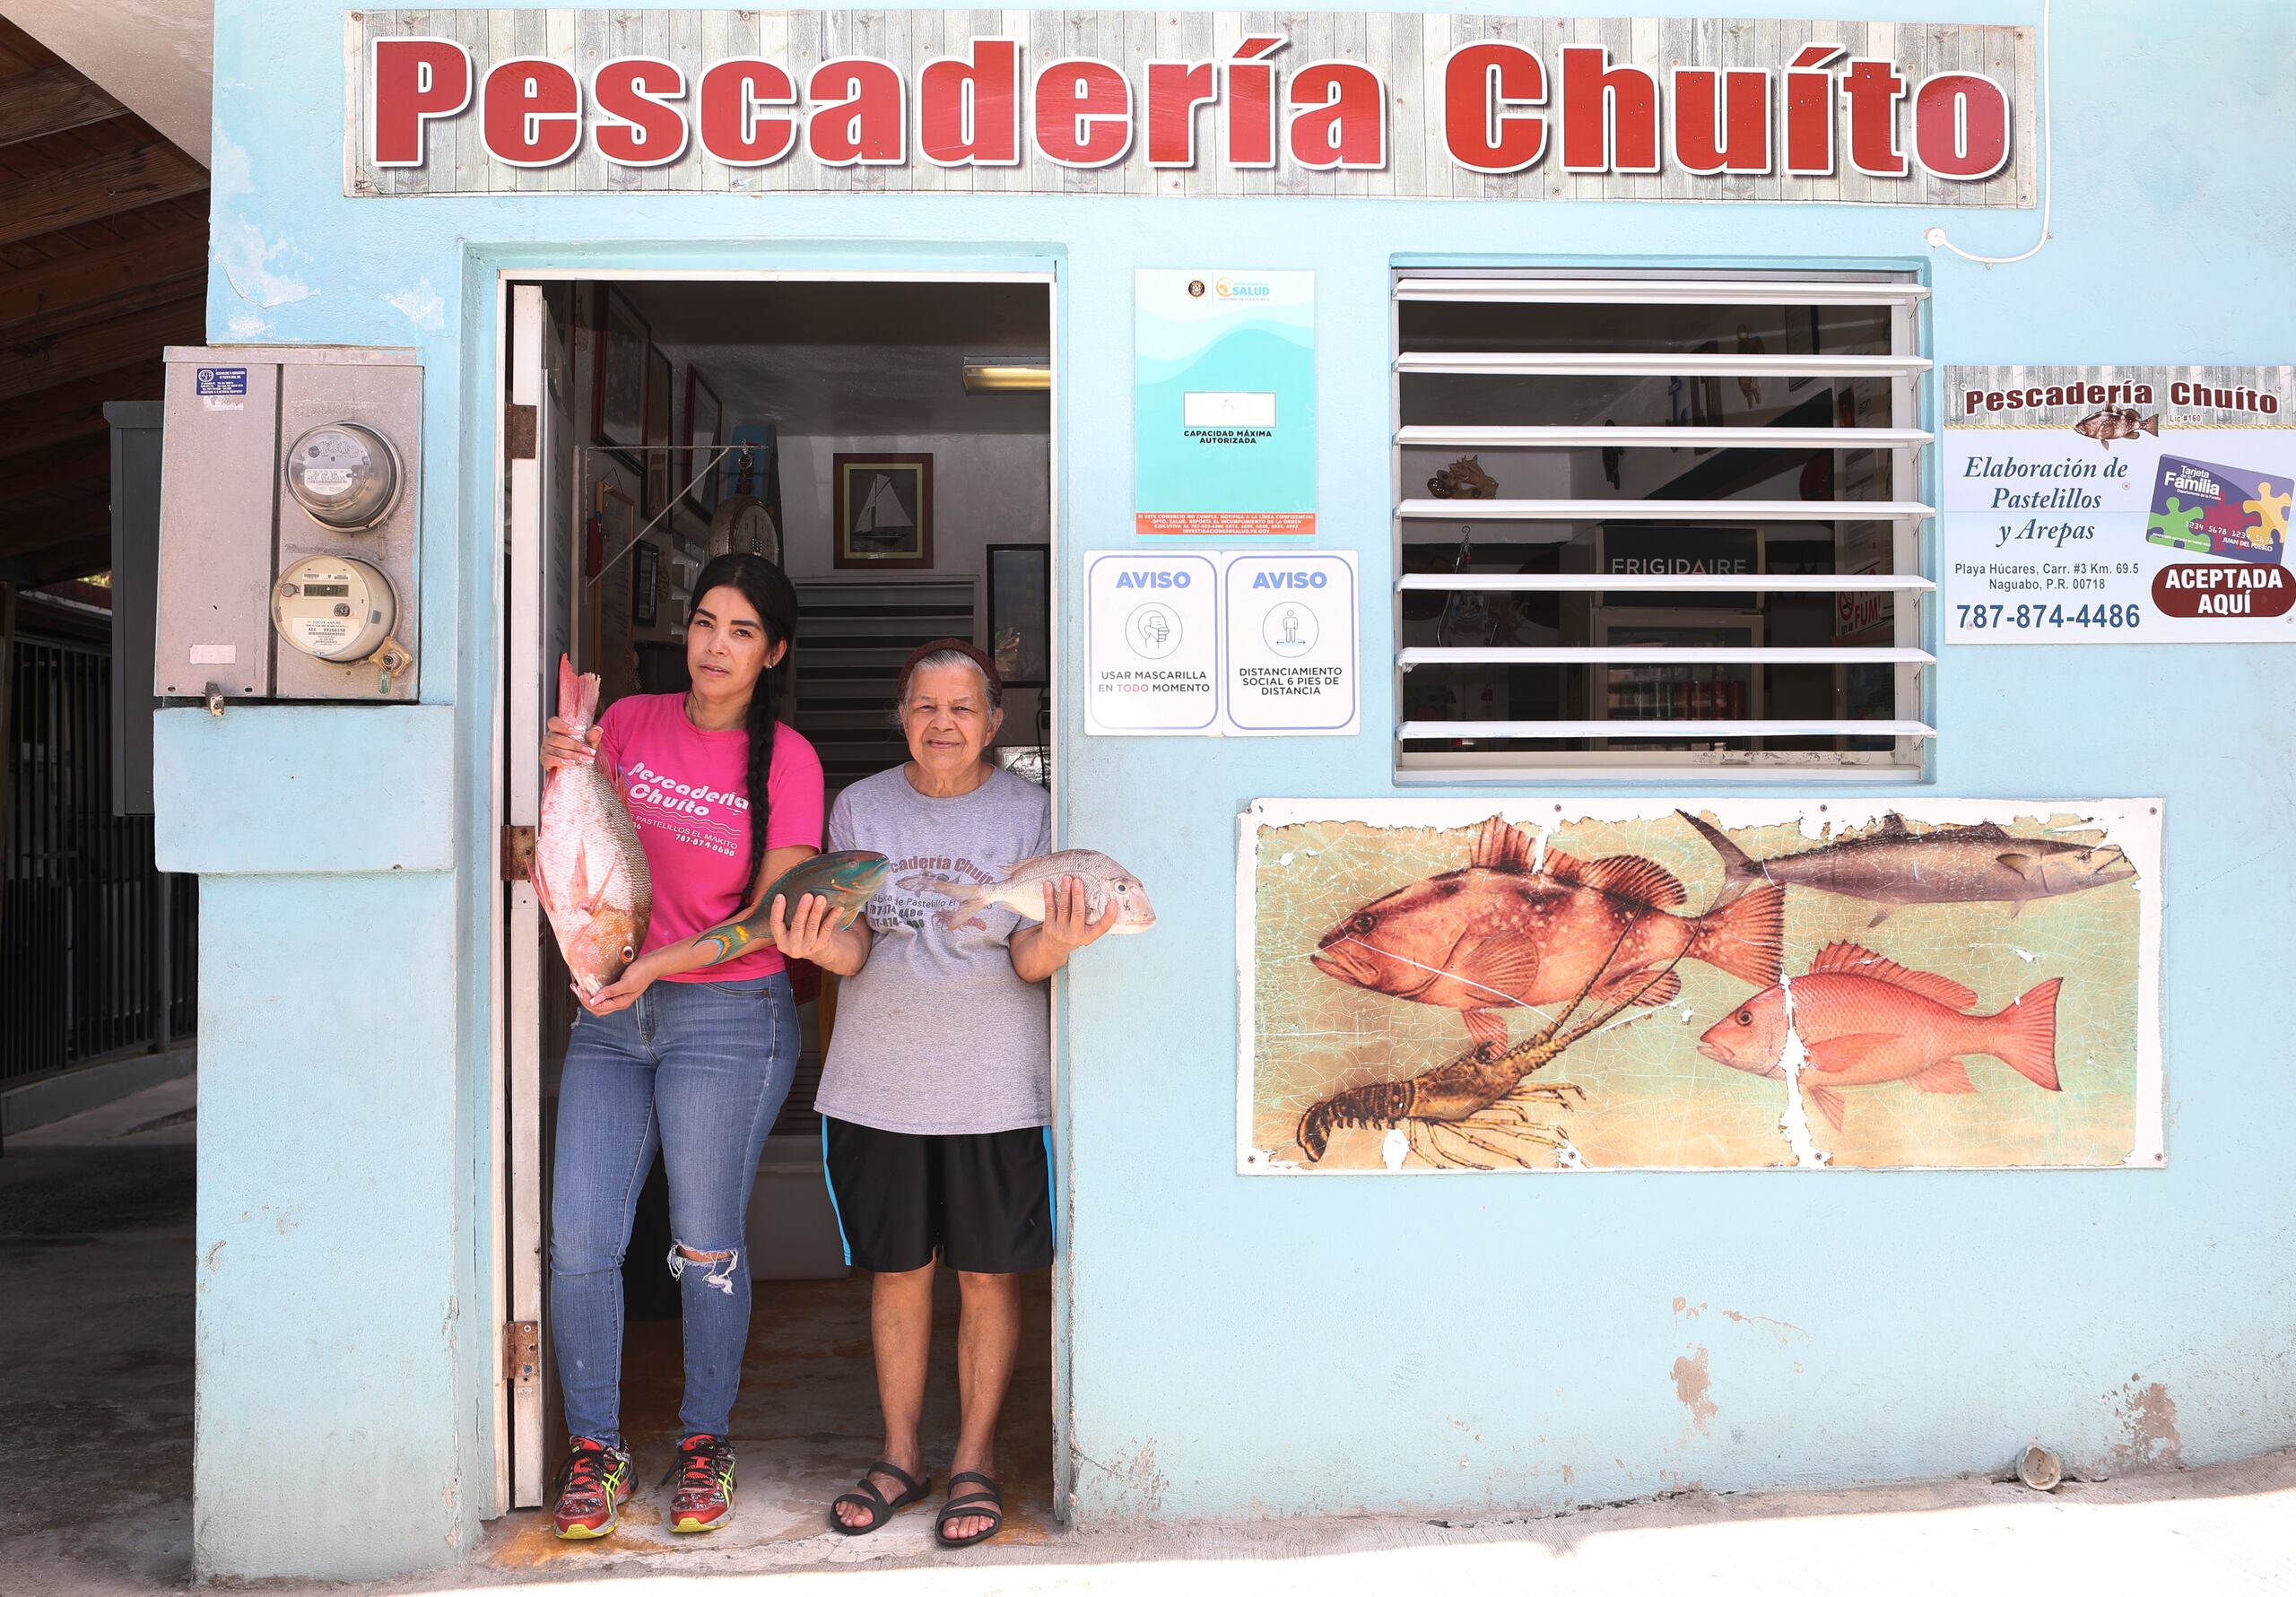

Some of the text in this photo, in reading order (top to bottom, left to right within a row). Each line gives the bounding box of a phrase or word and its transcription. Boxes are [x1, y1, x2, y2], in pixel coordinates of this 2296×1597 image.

[371, 32, 2010, 180] Pescadería Chuíto
[1232, 286, 1270, 296] SALUD
[1965, 378, 2280, 416] Pescadería Chuíto
[1237, 429, 1272, 437] MÁXIMA
[1963, 456, 2128, 478] Elaboración de
[2181, 465, 2209, 478] Tarjeta
[2164, 471, 2221, 496] Familia
[1990, 487, 2102, 509] Pastelillos
[1996, 518, 2095, 548] y Arepas
[2185, 521, 2204, 530] 1234
[2208, 525, 2228, 535] 5678
[2222, 537, 2274, 552] JUAN DEL PUEBLO
[1612, 558, 1746, 575] FRIGIDAIRE
[1955, 562, 2139, 577] Playa Húcares, Carr. #3 Km. 69.5
[1116, 571, 1191, 589] AVISO
[1252, 571, 1327, 589] AVISO
[1989, 578, 2105, 592] Naguabo, P.R. 00718
[2165, 568, 2283, 589] ACEPTADA
[2197, 589, 2251, 615] AQUÍ
[1957, 603, 2141, 629] 787-874-4486
[1101, 671, 1207, 680] USAR MASCARILLA
[1239, 666, 1343, 677] DISTANCIAMIENTO
[1099, 683, 1210, 692] EN TODO MOMENTO
[1242, 677, 1339, 686] SOCIAL 6 PIES DE
[1261, 686, 1321, 696] DISTANCIA
[630, 783, 710, 817] Chuíto
[636, 815, 691, 835] PASTELILLOS
[691, 830, 702, 838] EL
[705, 833, 738, 850] MAKITO
[675, 834, 735, 857] 787-874-8600
[890, 855, 996, 885] cadería Chuít
